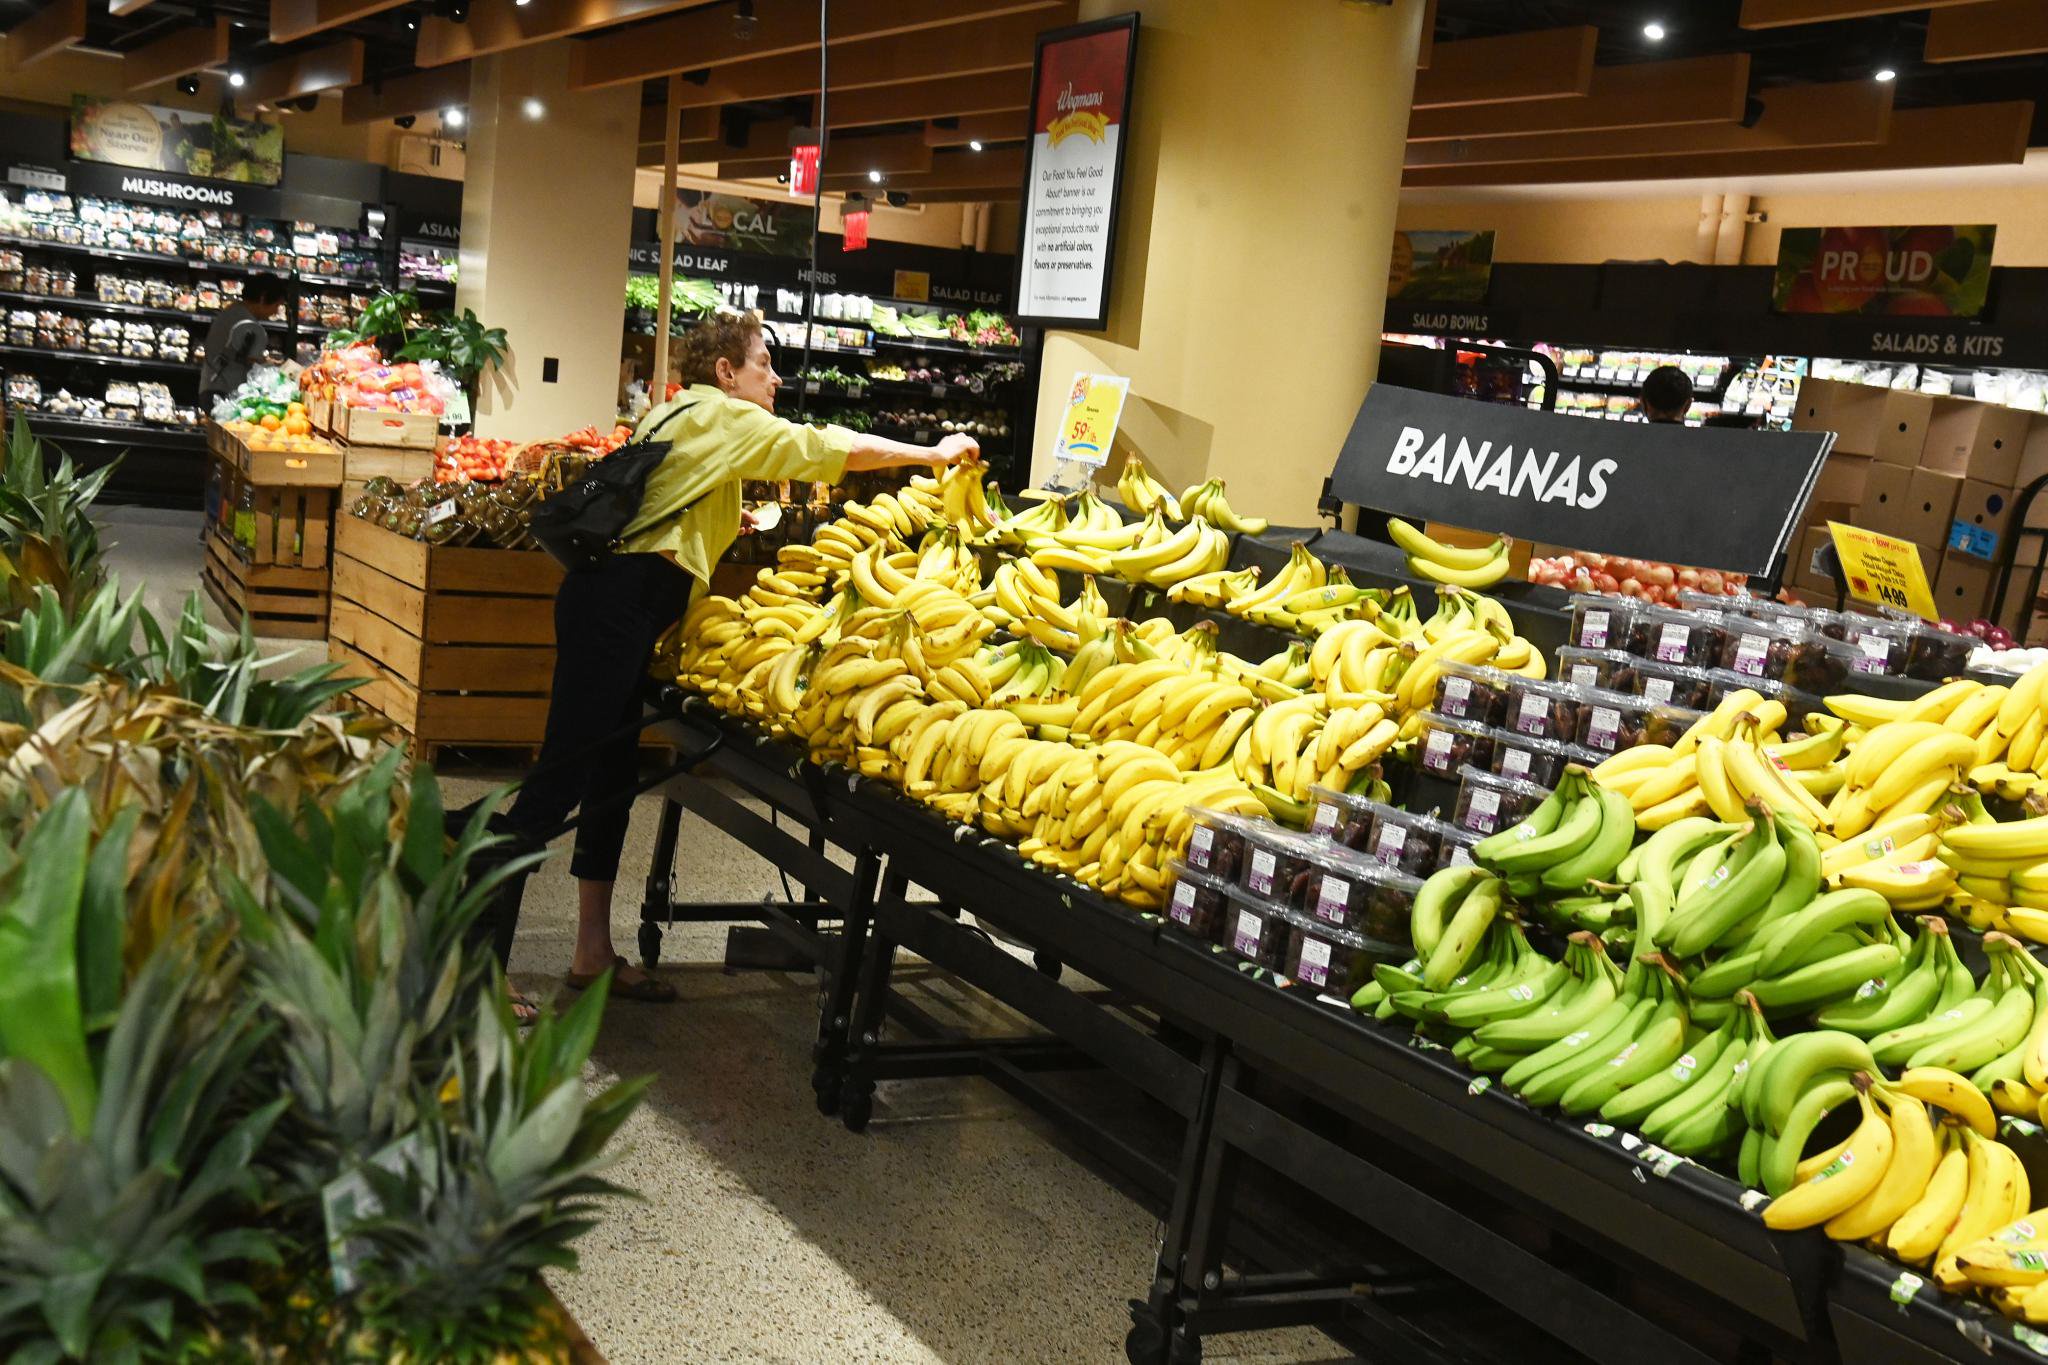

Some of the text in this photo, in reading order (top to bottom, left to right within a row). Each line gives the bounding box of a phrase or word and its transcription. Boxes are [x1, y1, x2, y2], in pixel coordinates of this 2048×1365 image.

[1057, 81, 1104, 120] Wegmans
[1042, 165, 1104, 181] Our Food You Feel Good
[121, 176, 234, 206] MUSHROOMS
[1063, 187, 1080, 198] banner
[1086, 187, 1096, 196] our
[1035, 204, 1104, 218] commitment to bringing you
[1035, 220, 1100, 237] exceptional products made
[1037, 241, 1047, 252] with
[1047, 243, 1054, 252] no
[1054, 239, 1076, 252] artificial
[697, 256, 729, 273] LEAF
[1034, 258, 1050, 271] flavors
[1050, 261, 1056, 270] or
[932, 285, 970, 301] SALAD
[974, 290, 1004, 305] LEAF
[1412, 312, 1488, 331] SALAD BOWLS
[1871, 332, 2004, 357] SALADS & KITS
[1386, 426, 1619, 510] BANANAS
